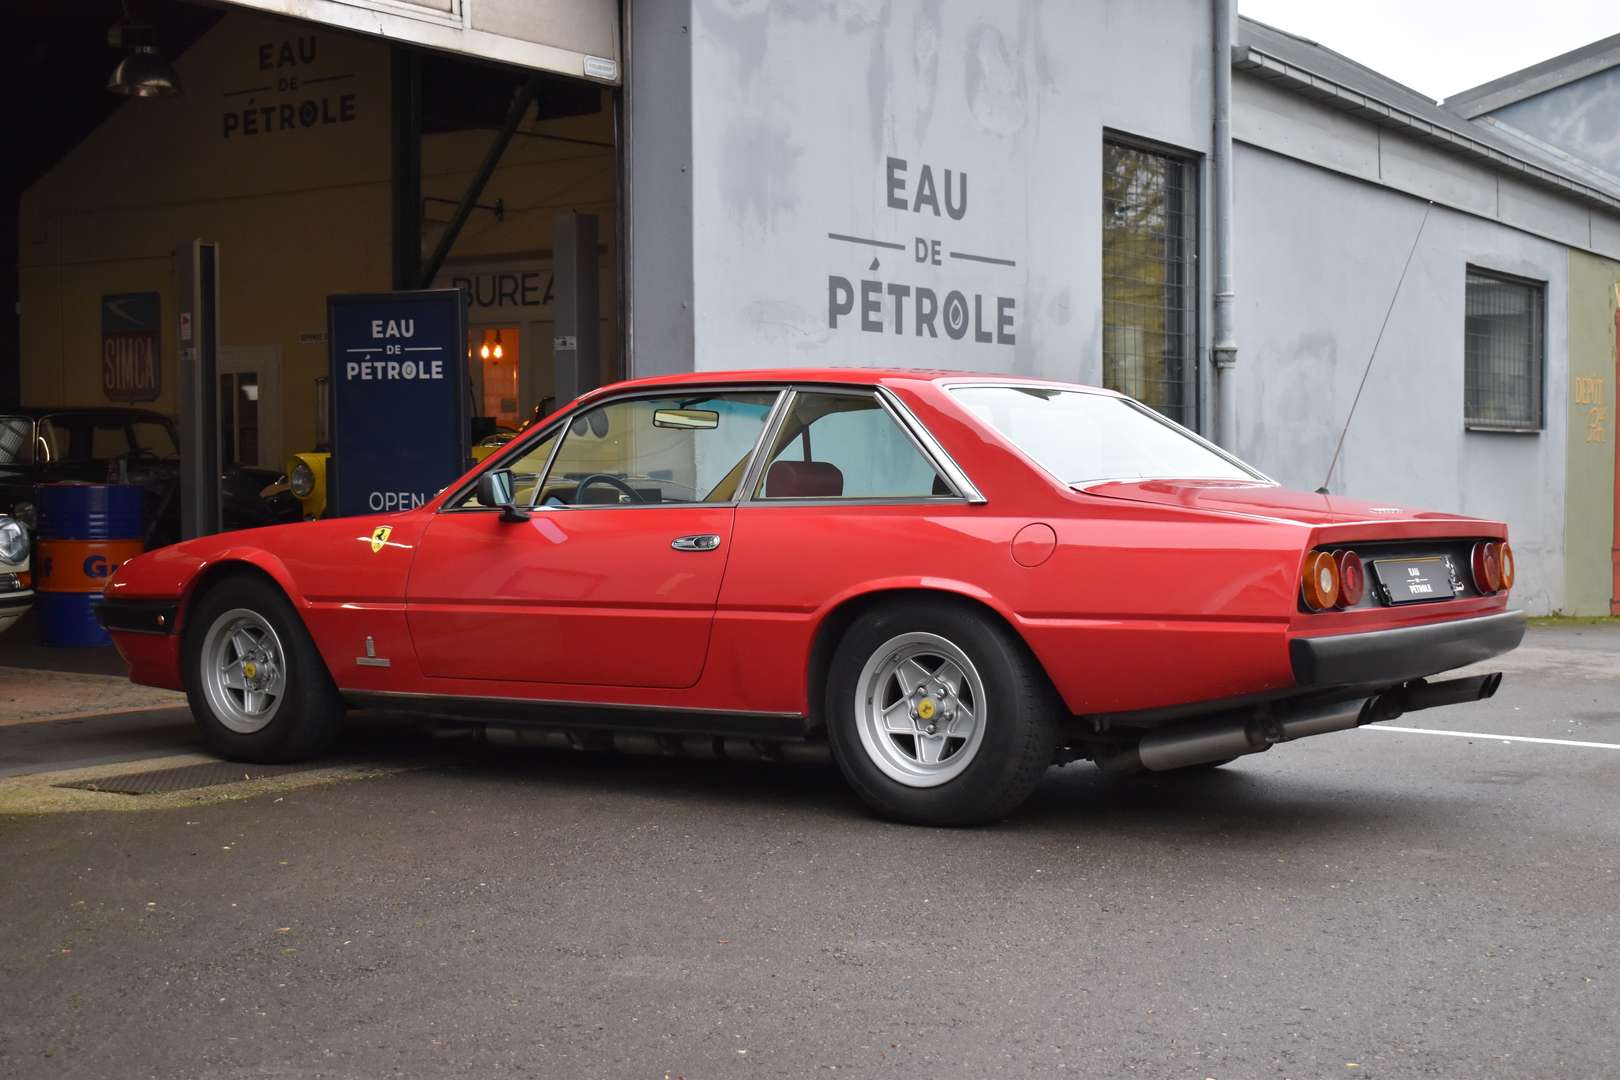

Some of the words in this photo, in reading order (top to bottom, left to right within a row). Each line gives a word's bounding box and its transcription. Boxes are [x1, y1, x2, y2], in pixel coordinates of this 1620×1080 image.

[258, 35, 317, 71] EAU
[277, 76, 298, 92] DE
[223, 96, 356, 139] PÉTROLE
[886, 156, 967, 221] EAU
[914, 236, 942, 266] DE
[452, 272, 554, 307] BUREA
[828, 257, 1016, 345] PÉTROLE
[371, 319, 415, 339] EAU
[104, 336, 155, 390] SIMCA
[386, 344, 402, 355] DE
[346, 353, 444, 380] PÉTROLE
[369, 491, 425, 511] OPEN
